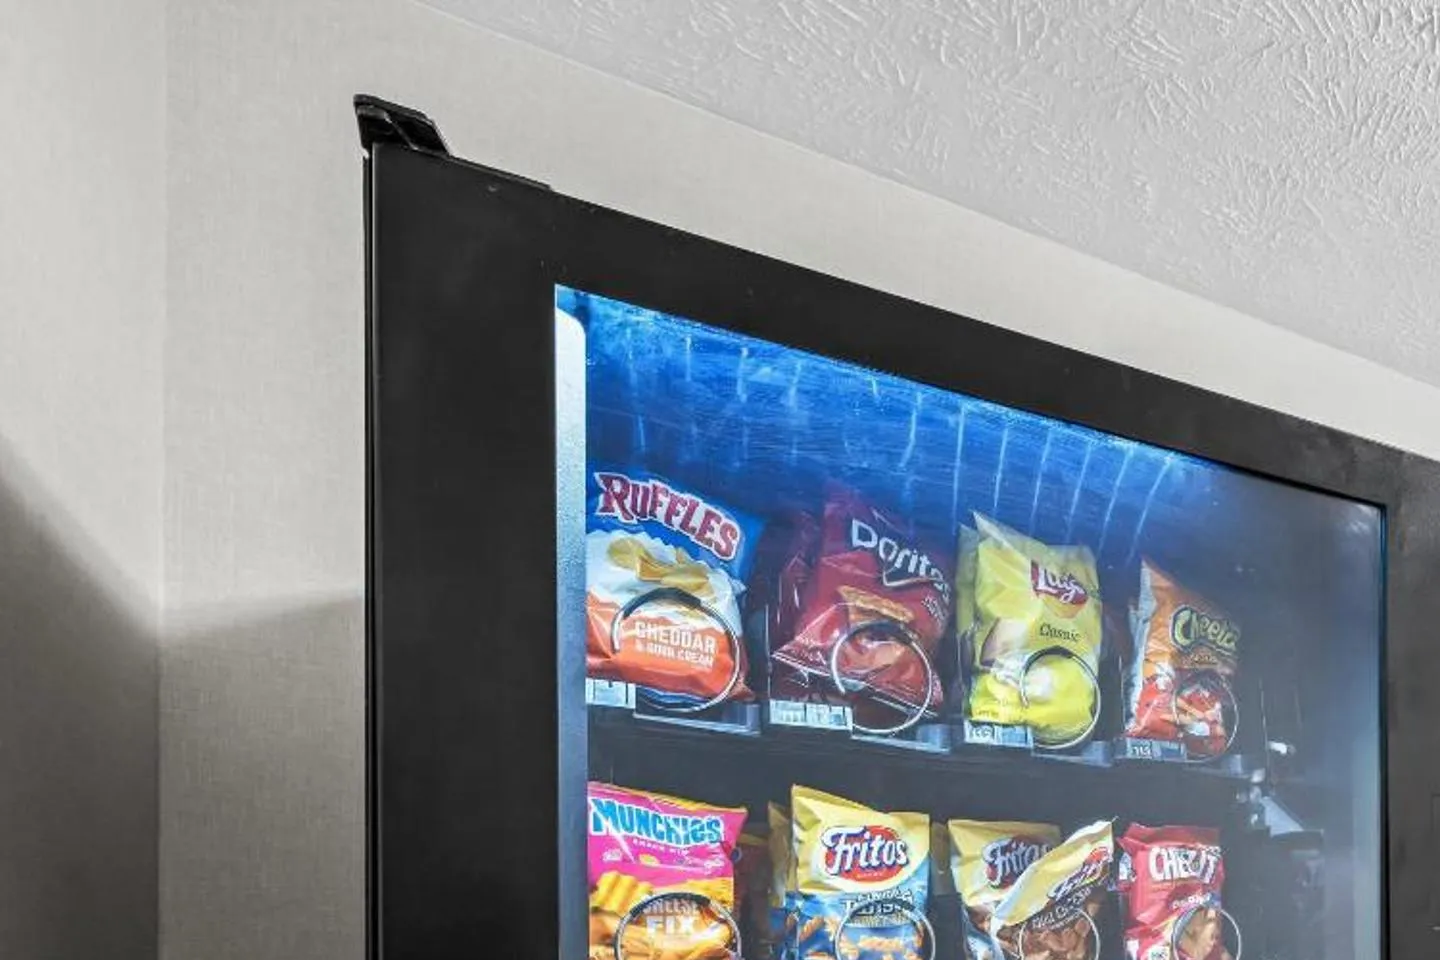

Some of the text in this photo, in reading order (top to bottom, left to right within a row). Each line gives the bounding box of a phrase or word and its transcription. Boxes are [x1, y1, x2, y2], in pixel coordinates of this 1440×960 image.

[594, 472, 739, 560] RUFFLES
[851, 518, 950, 604] Doritos
[1036, 564, 1085, 604] Lay's
[634, 620, 716, 655] CHEDDAR
[1038, 622, 1081, 644] Classic
[590, 798, 723, 848] MUNCHIES
[821, 825, 909, 876] Fritos
[646, 915, 697, 937] FIX
